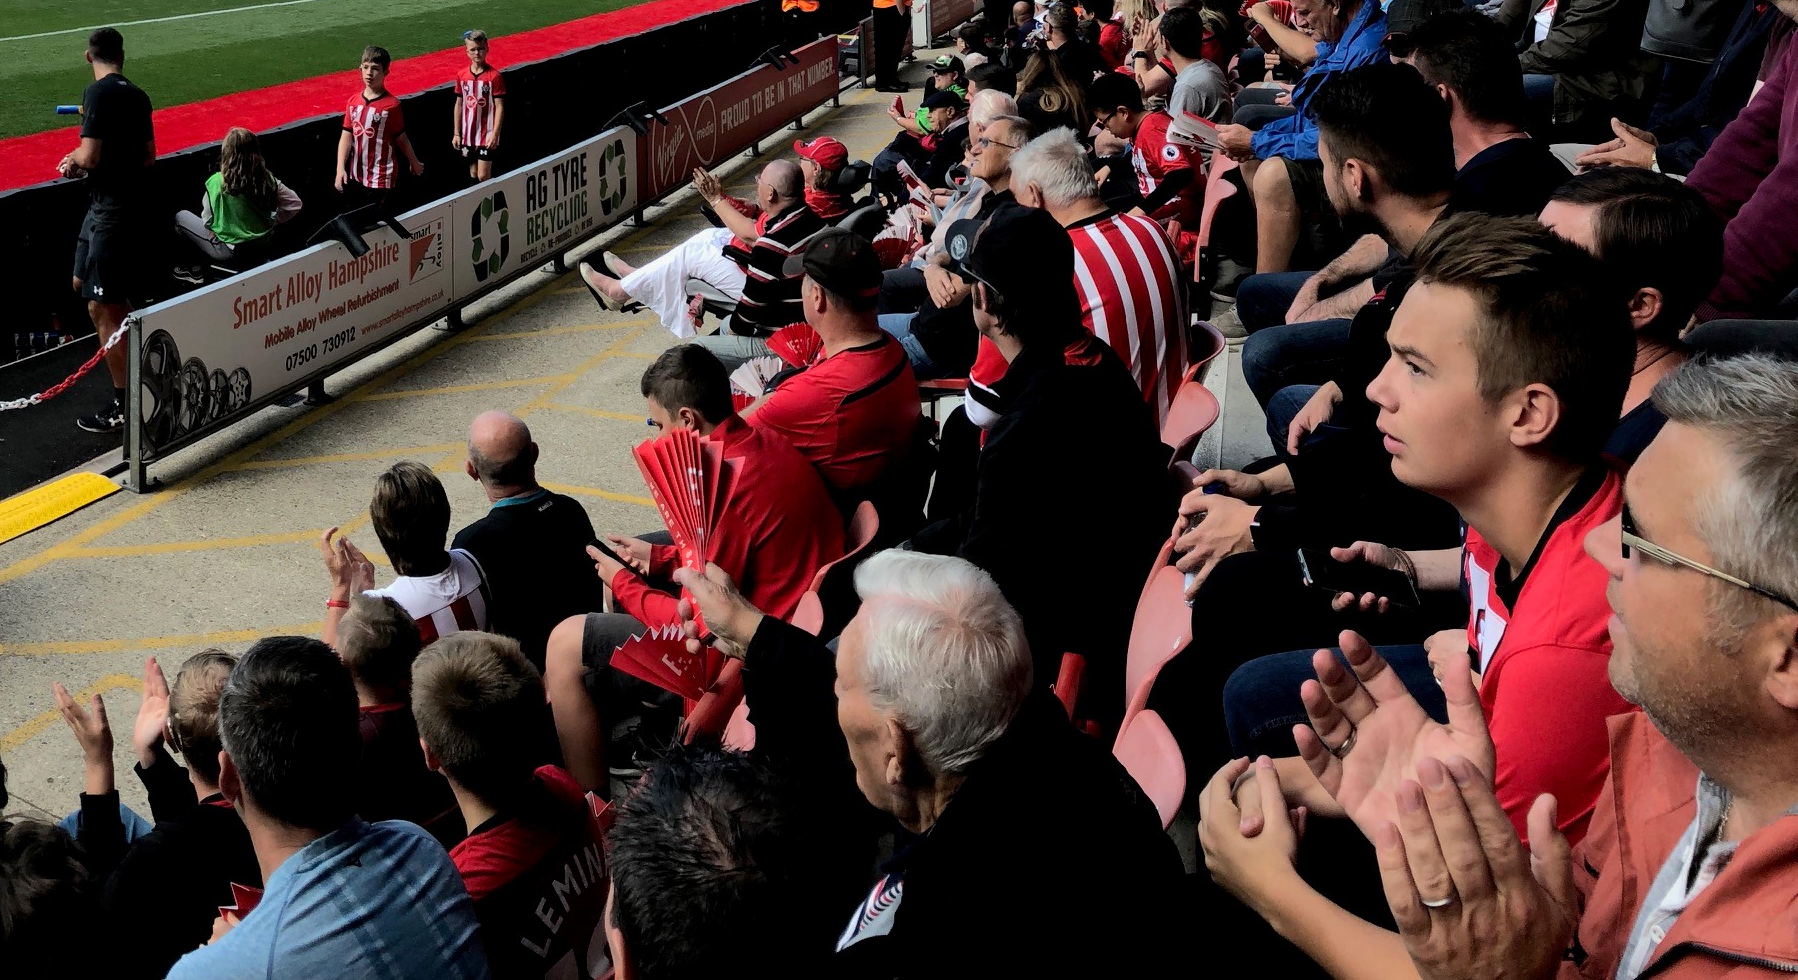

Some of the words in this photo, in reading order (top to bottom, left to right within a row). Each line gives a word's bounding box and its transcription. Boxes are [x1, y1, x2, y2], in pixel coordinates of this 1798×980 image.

[720, 98, 750, 134] PROUD
[752, 92, 763, 116] TO
[764, 87, 776, 110] BE
[778, 80, 786, 104] IN
[788, 72, 806, 98] THAT
[807, 56, 836, 88] NUMBER.
[696, 122, 714, 142] media
[526, 170, 548, 214] AG
[552, 152, 588, 202] TYRE
[526, 190, 588, 246] RECYCLING
[520, 246, 538, 264] RECYCLE
[234, 284, 282, 330] Smart
[286, 270, 322, 308] Alloy
[328, 240, 400, 290] Hampshire
[361, 288, 444, 335] www.smartalloyhampshire.co.uk
[265, 325, 294, 349] Mobile
[296, 316, 317, 336] Alloy
[318, 301, 346, 324] Wheel
[347, 278, 400, 313] Refurbishment
[286, 344, 317, 372] 07500
[322, 326, 356, 354] 730912
[660, 502, 674, 528] ARE
[520, 842, 612, 958] LEMIN
